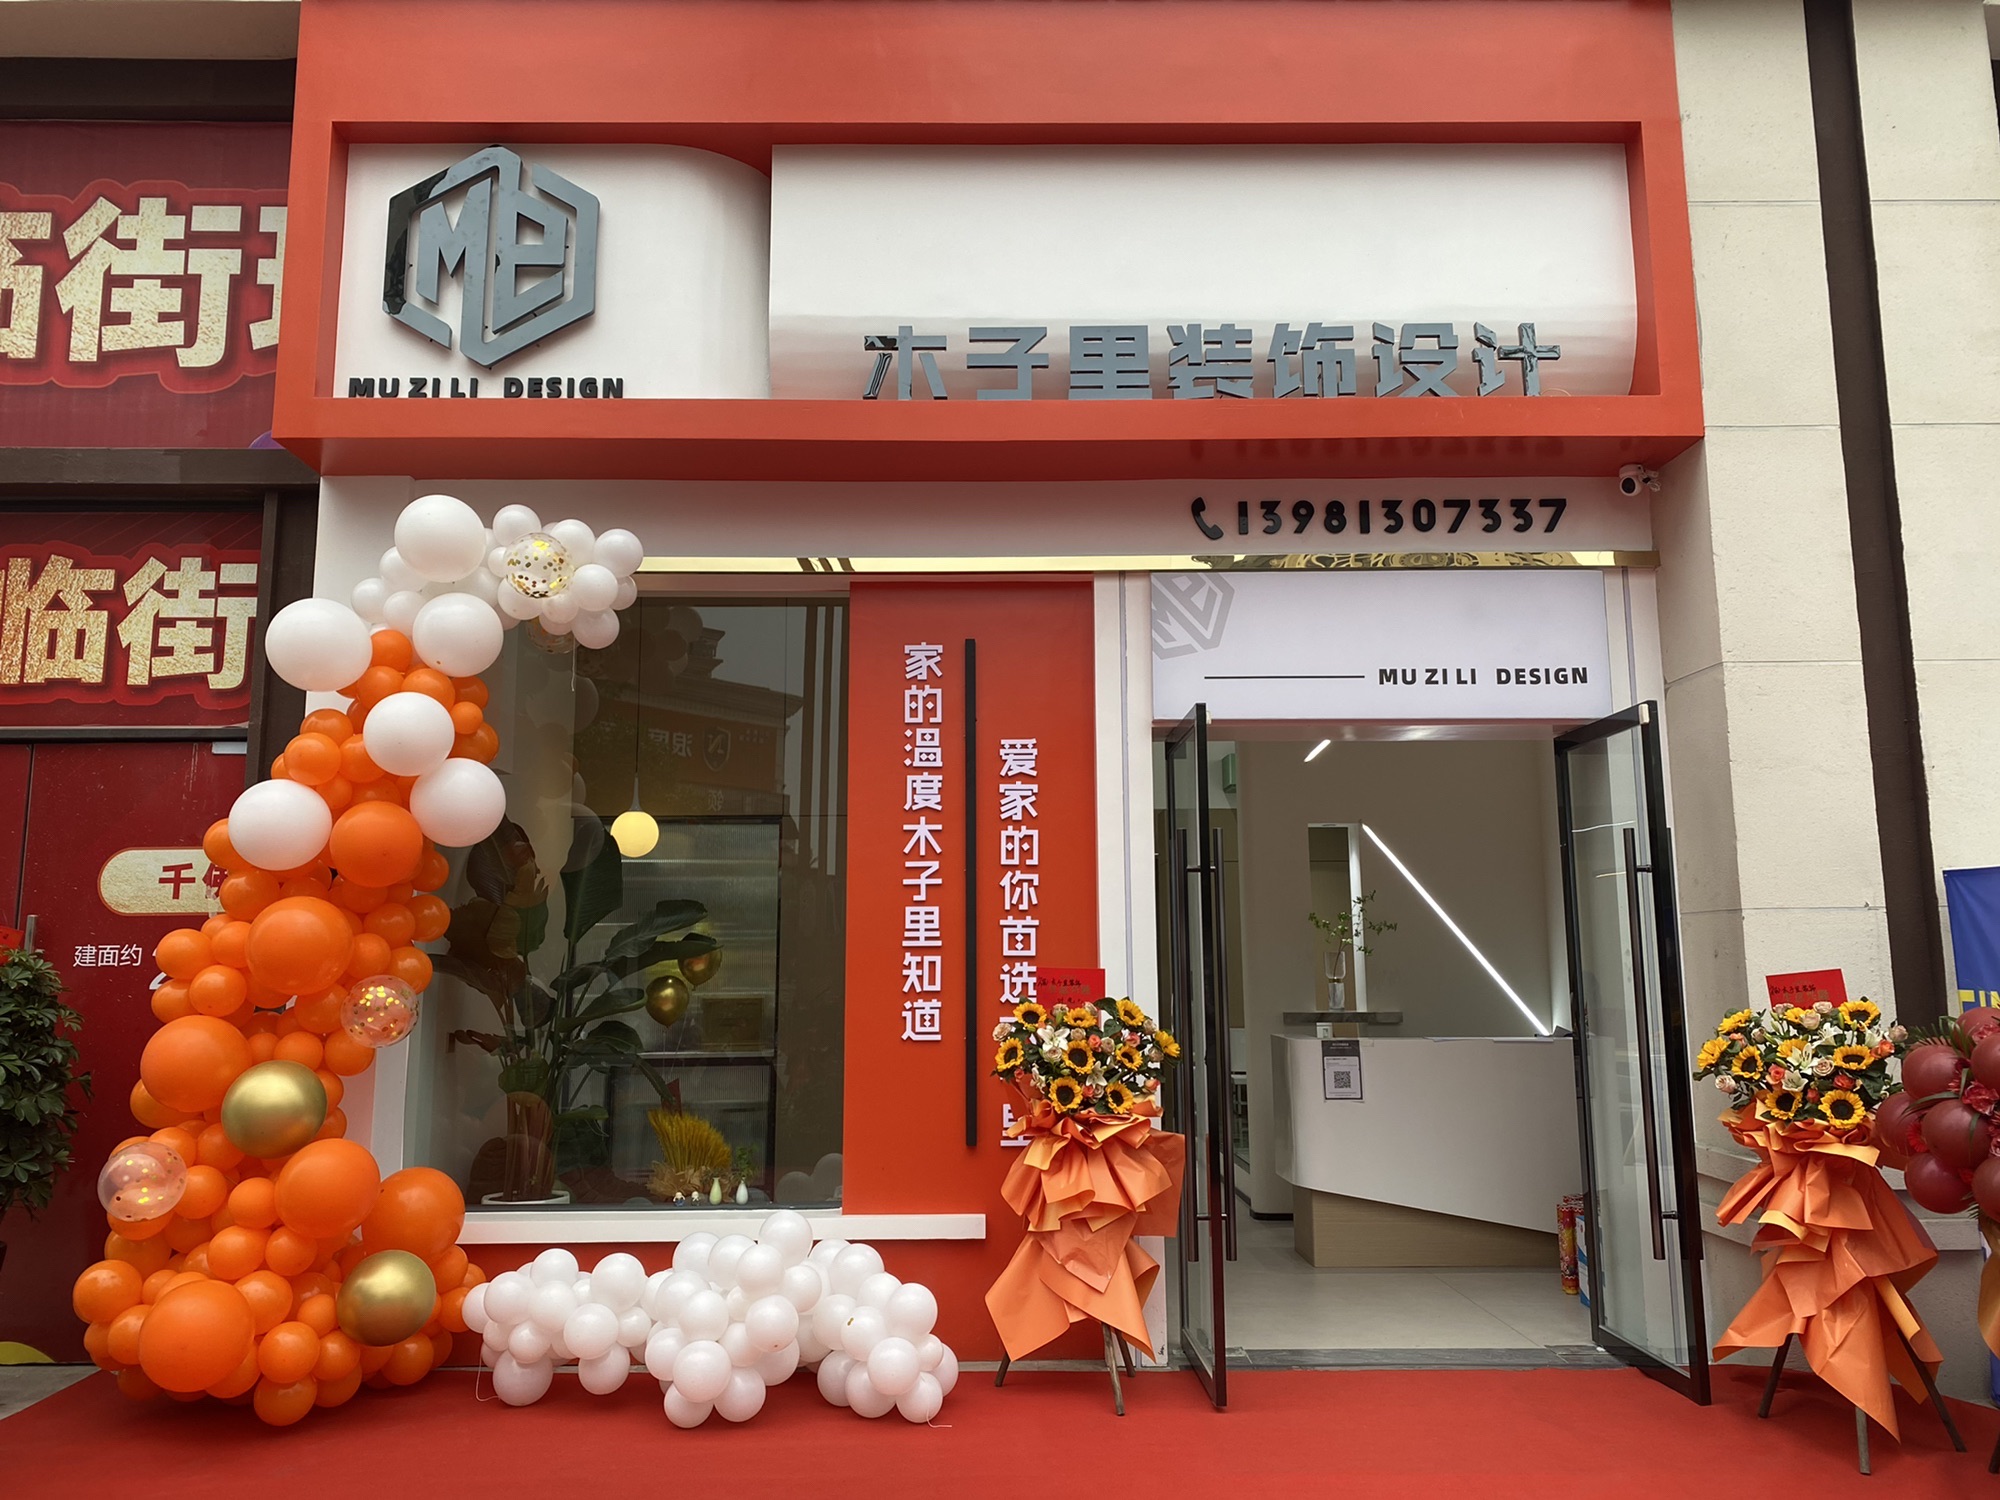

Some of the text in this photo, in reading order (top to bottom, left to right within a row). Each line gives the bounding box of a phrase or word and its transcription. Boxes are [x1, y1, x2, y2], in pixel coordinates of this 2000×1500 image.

[862, 322, 1560, 399] 木子里装饰设计
[503, 377, 624, 398] DESIGN
[1238, 499, 1567, 535] 13981307337
[1496, 667, 1588, 685] DESIGN
[903, 642, 943, 1041] 家的温度木子里知道
[72, 944, 142, 967] 建面约
